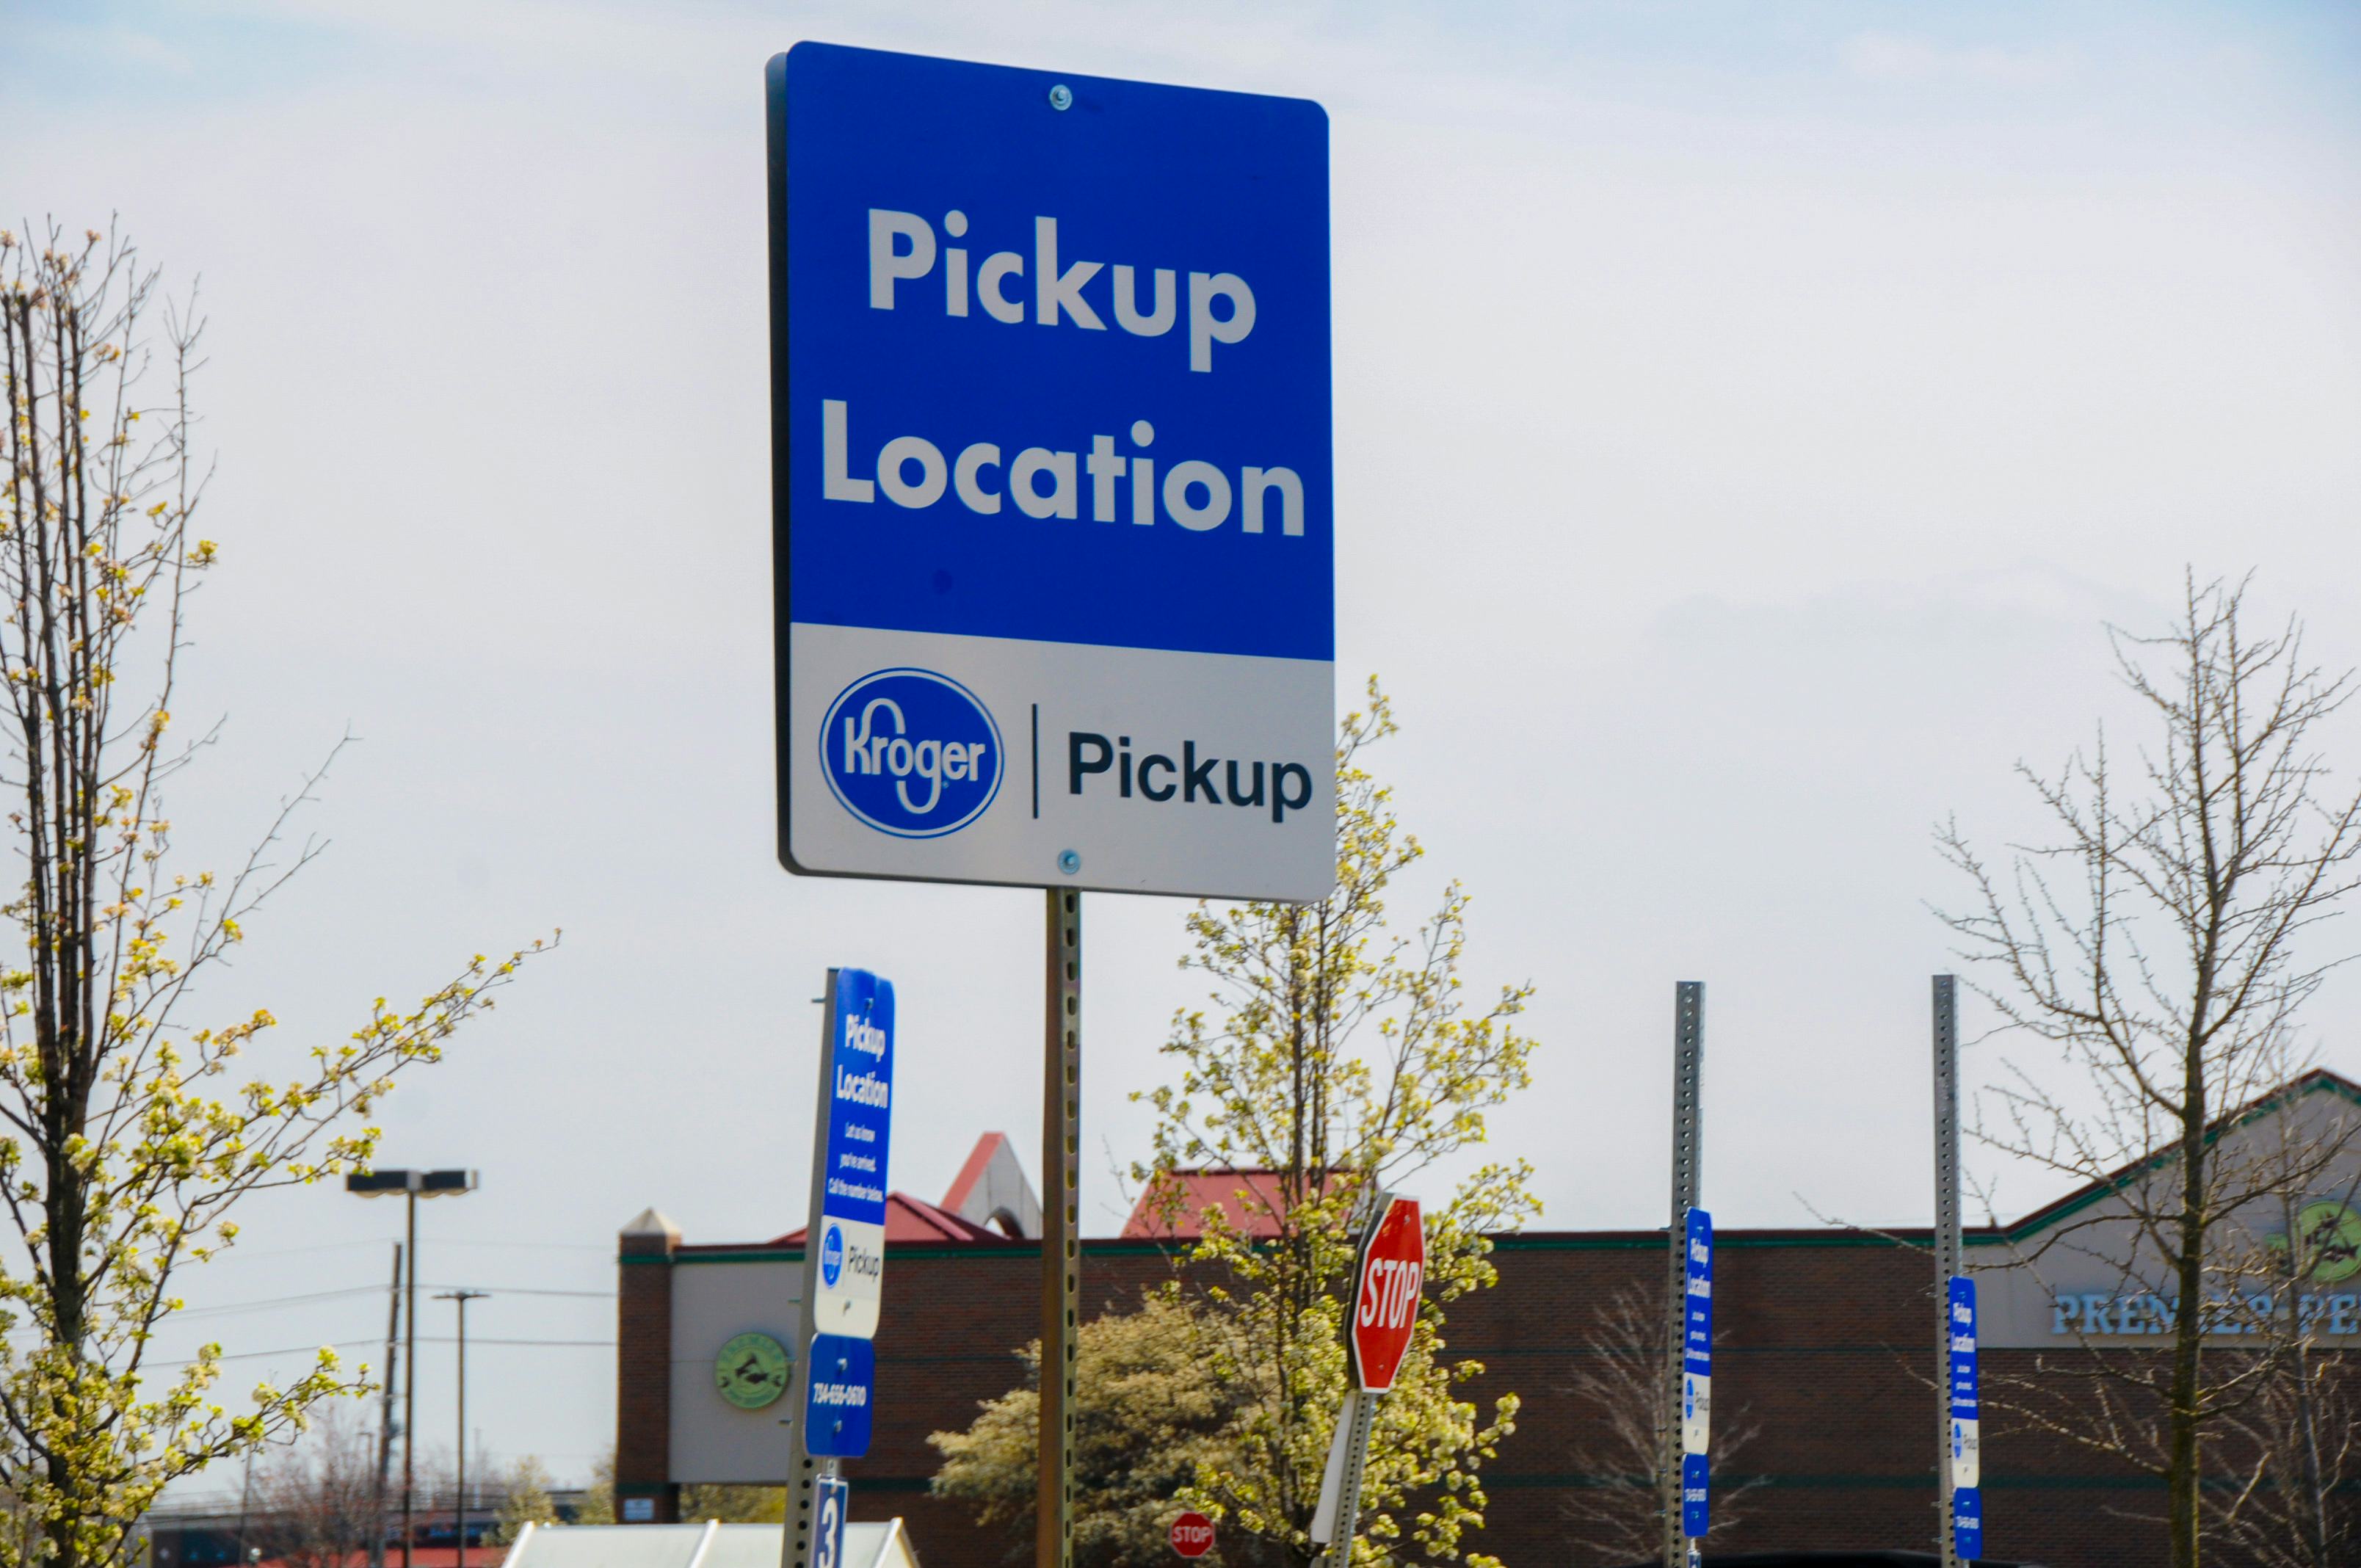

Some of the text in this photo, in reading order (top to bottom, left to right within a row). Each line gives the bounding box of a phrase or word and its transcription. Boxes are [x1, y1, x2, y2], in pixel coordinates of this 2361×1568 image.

[868, 208, 1257, 373] Pickup
[822, 399, 1305, 537] Location
[844, 697, 986, 815] Kroger
[1068, 731, 1313, 823] Pickup
[845, 1014, 886, 1062] Pickup
[837, 1064, 889, 1108] Location
[847, 1246, 880, 1283] Pickup
[1360, 1257, 1421, 1329] STOP
[818, 1497, 838, 1568] 3
[1172, 1525, 1211, 1544] STOP
